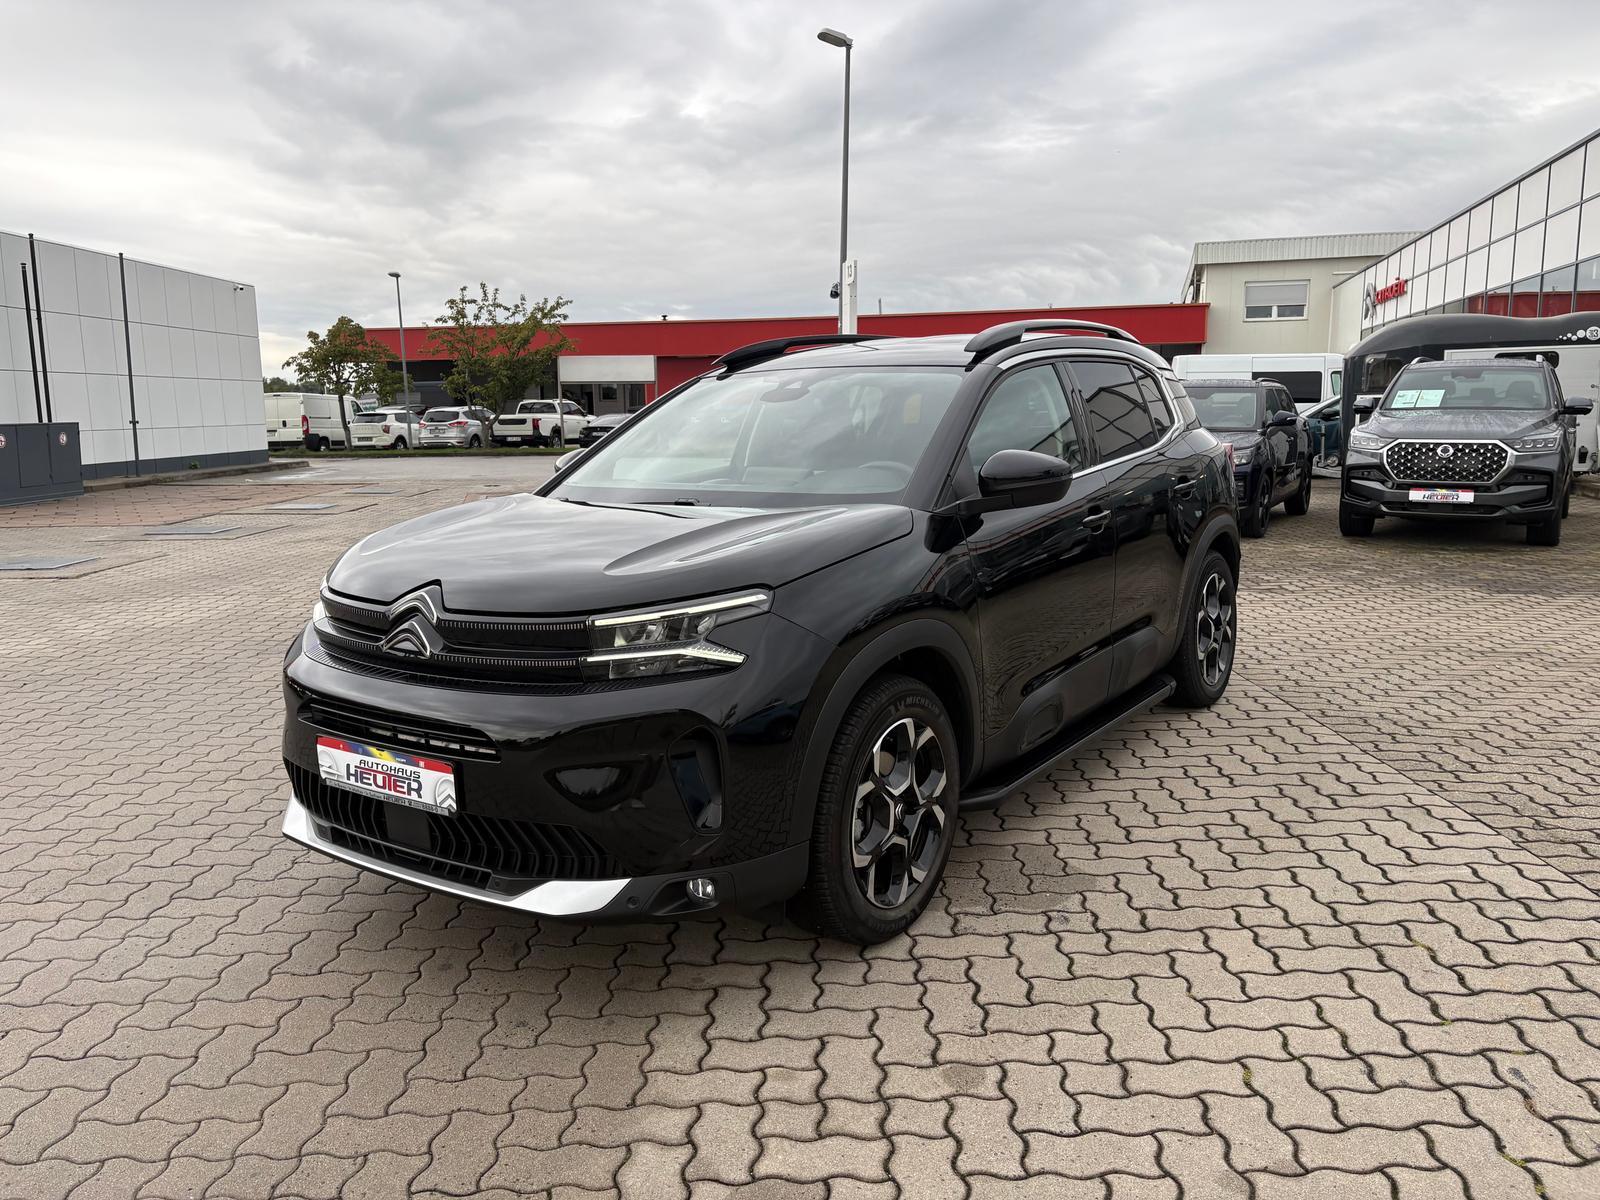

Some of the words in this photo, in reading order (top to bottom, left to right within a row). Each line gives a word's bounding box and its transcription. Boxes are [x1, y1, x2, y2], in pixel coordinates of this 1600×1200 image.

[905, 696, 940, 715] MICHELIN
[358, 759, 421, 780] AUTOHAUS
[346, 763, 423, 799] HEUTER
